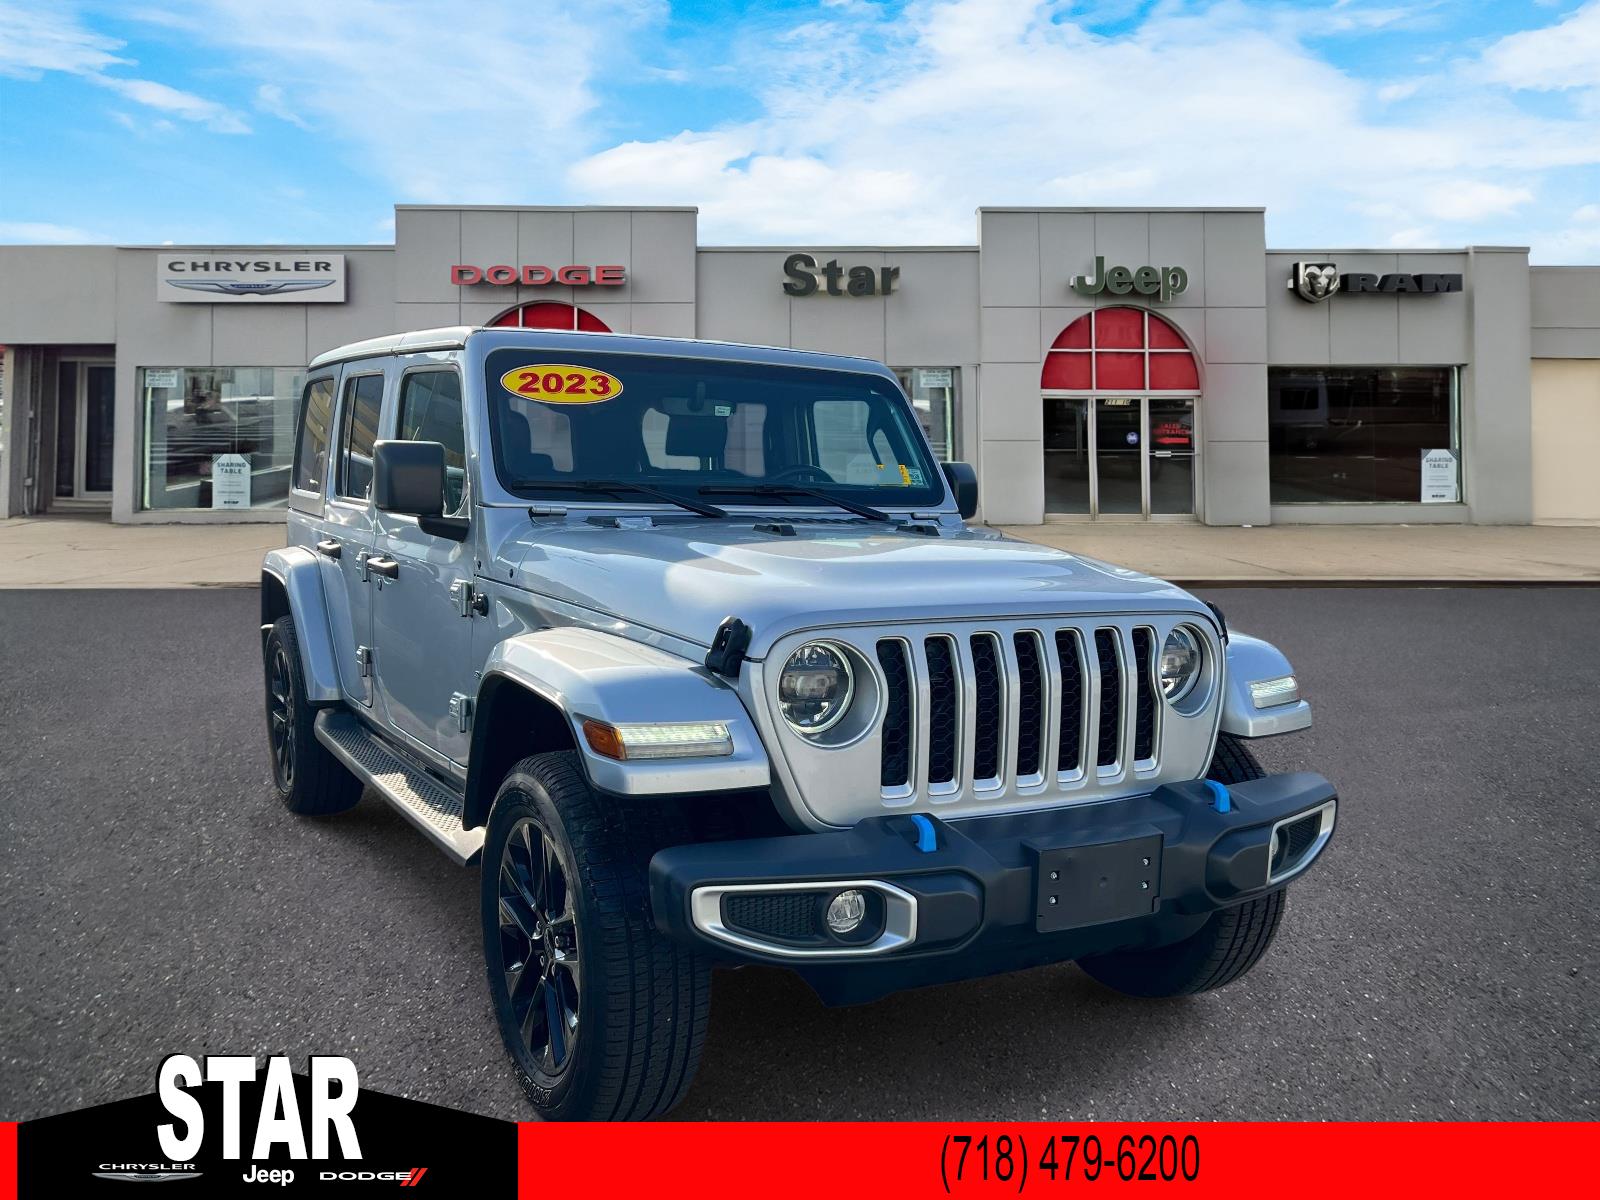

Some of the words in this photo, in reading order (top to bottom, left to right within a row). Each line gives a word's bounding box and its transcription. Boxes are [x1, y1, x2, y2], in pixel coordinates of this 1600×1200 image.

[168, 261, 332, 272] CHRYSLER
[451, 265, 627, 285] DODGE
[783, 253, 900, 297] Star
[1070, 256, 1188, 301] Jeep
[1340, 273, 1463, 292] RAM
[517, 372, 612, 396] 2023
